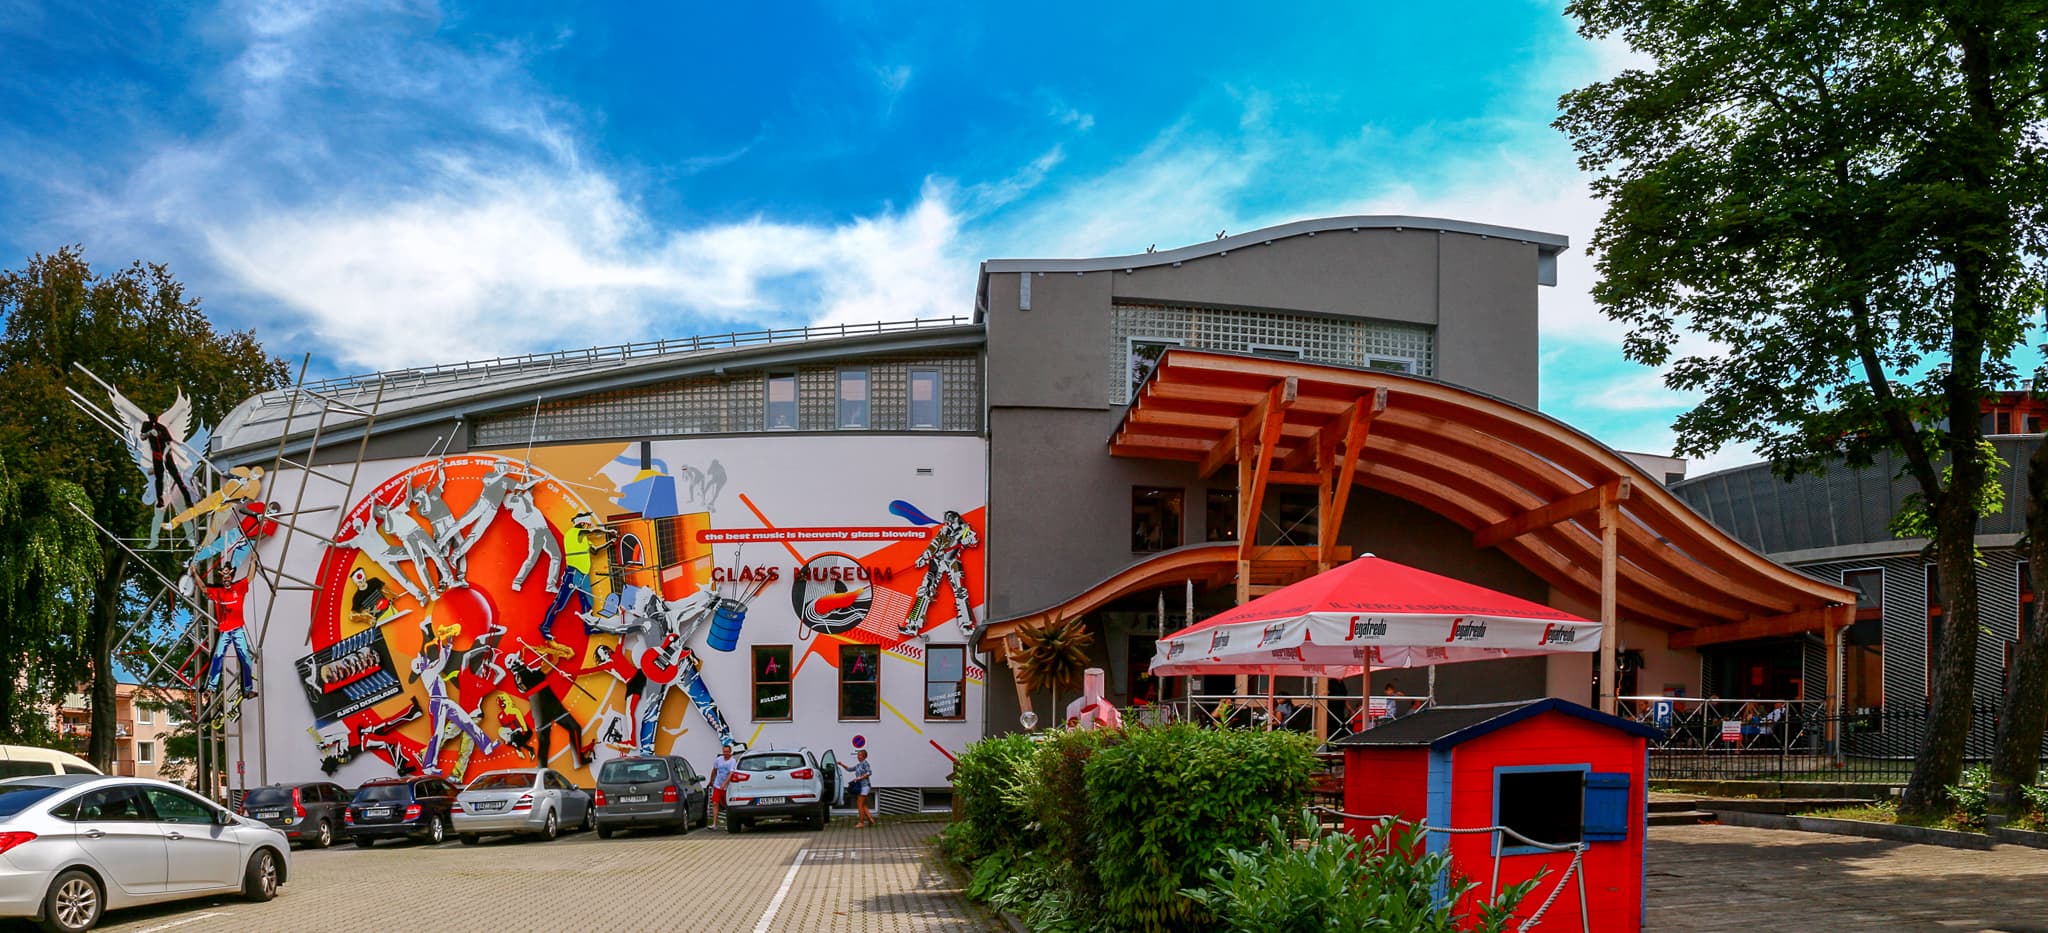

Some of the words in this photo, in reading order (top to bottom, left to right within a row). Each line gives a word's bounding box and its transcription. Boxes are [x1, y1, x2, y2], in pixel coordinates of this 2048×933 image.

[704, 533, 723, 541] the
[726, 532, 750, 540] best
[752, 531, 785, 540] music
[787, 531, 796, 539] is
[798, 530, 848, 540] heavenly
[851, 530, 880, 540] glass
[882, 529, 926, 539] blowing
[712, 566, 780, 582] GLASS
[794, 566, 892, 582] MUSEUM
[1345, 616, 1386, 641] Segafredo
[1445, 618, 1487, 642] Segafredo
[1538, 623, 1575, 645] Segafredo
[360, 687, 398, 707] DIXIELAND
[1658, 702, 1669, 721] P
